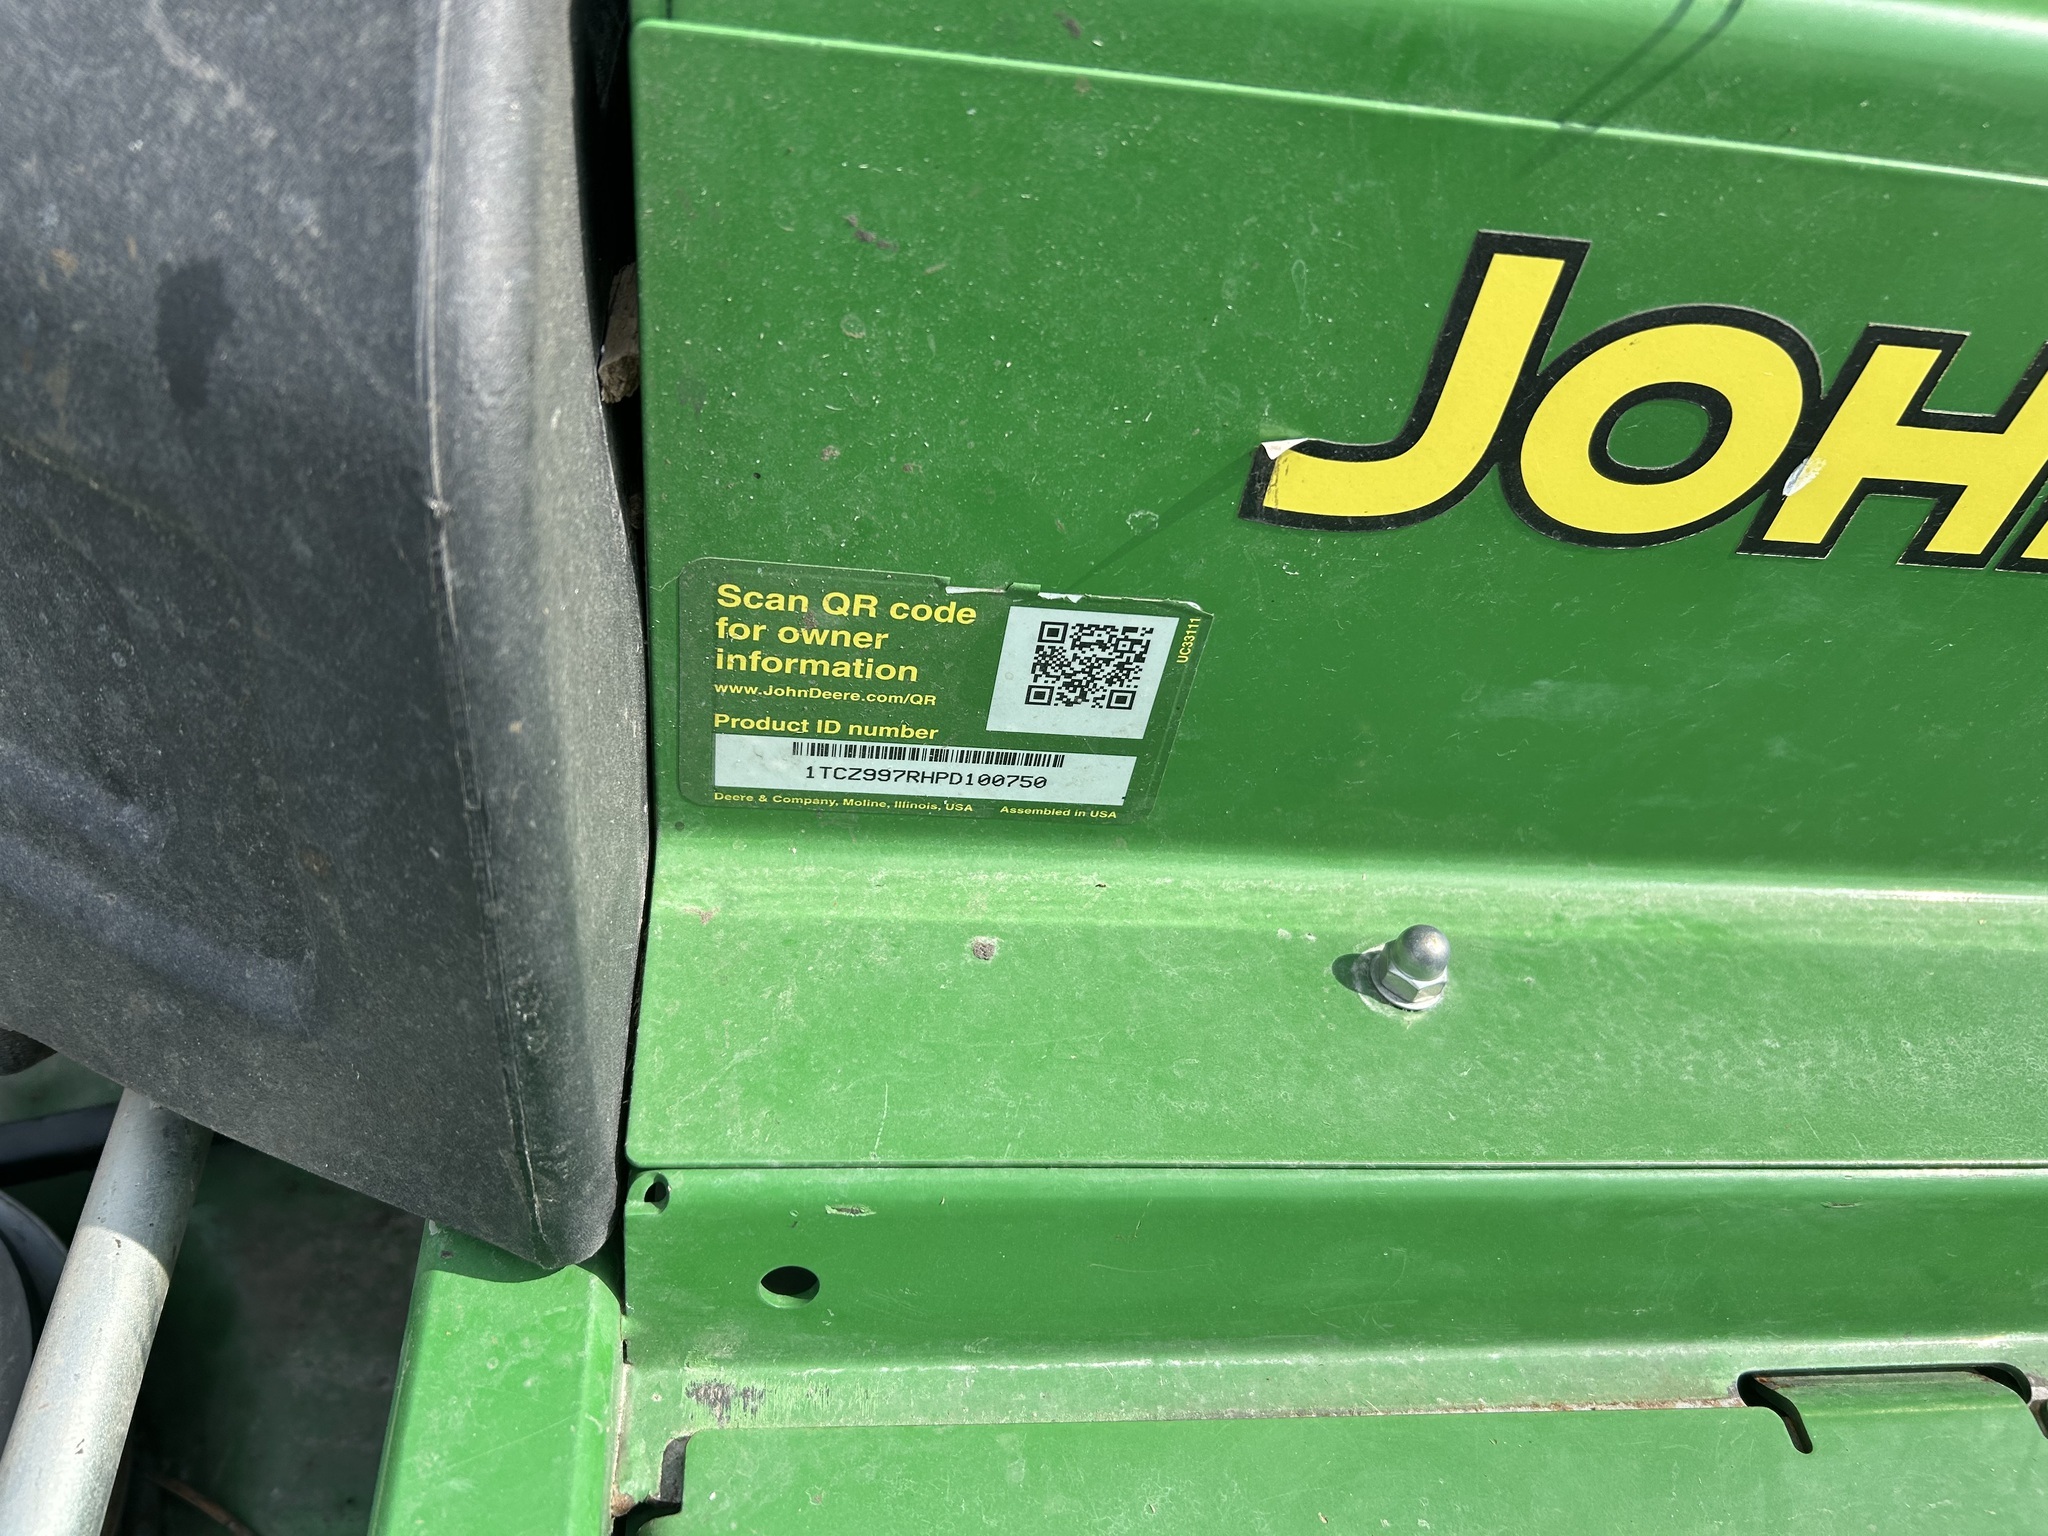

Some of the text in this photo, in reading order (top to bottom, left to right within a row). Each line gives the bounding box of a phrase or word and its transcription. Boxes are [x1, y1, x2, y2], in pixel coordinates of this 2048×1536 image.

[1238, 229, 2048, 573] JOH
[716, 583, 977, 625] Scan QR code
[715, 616, 889, 650] for owner
[1176, 617, 1202, 663] UC33111
[715, 647, 918, 683] information
[713, 684, 937, 706] www.JohnDeere.com/QR
[713, 713, 939, 740] Product ID number
[805, 765, 1048, 789] 1TCZ997RHPD100750
[713, 792, 974, 812] Deere & Company, Moline, Illinois, USA
[999, 805, 1118, 819] Assembled in USA
